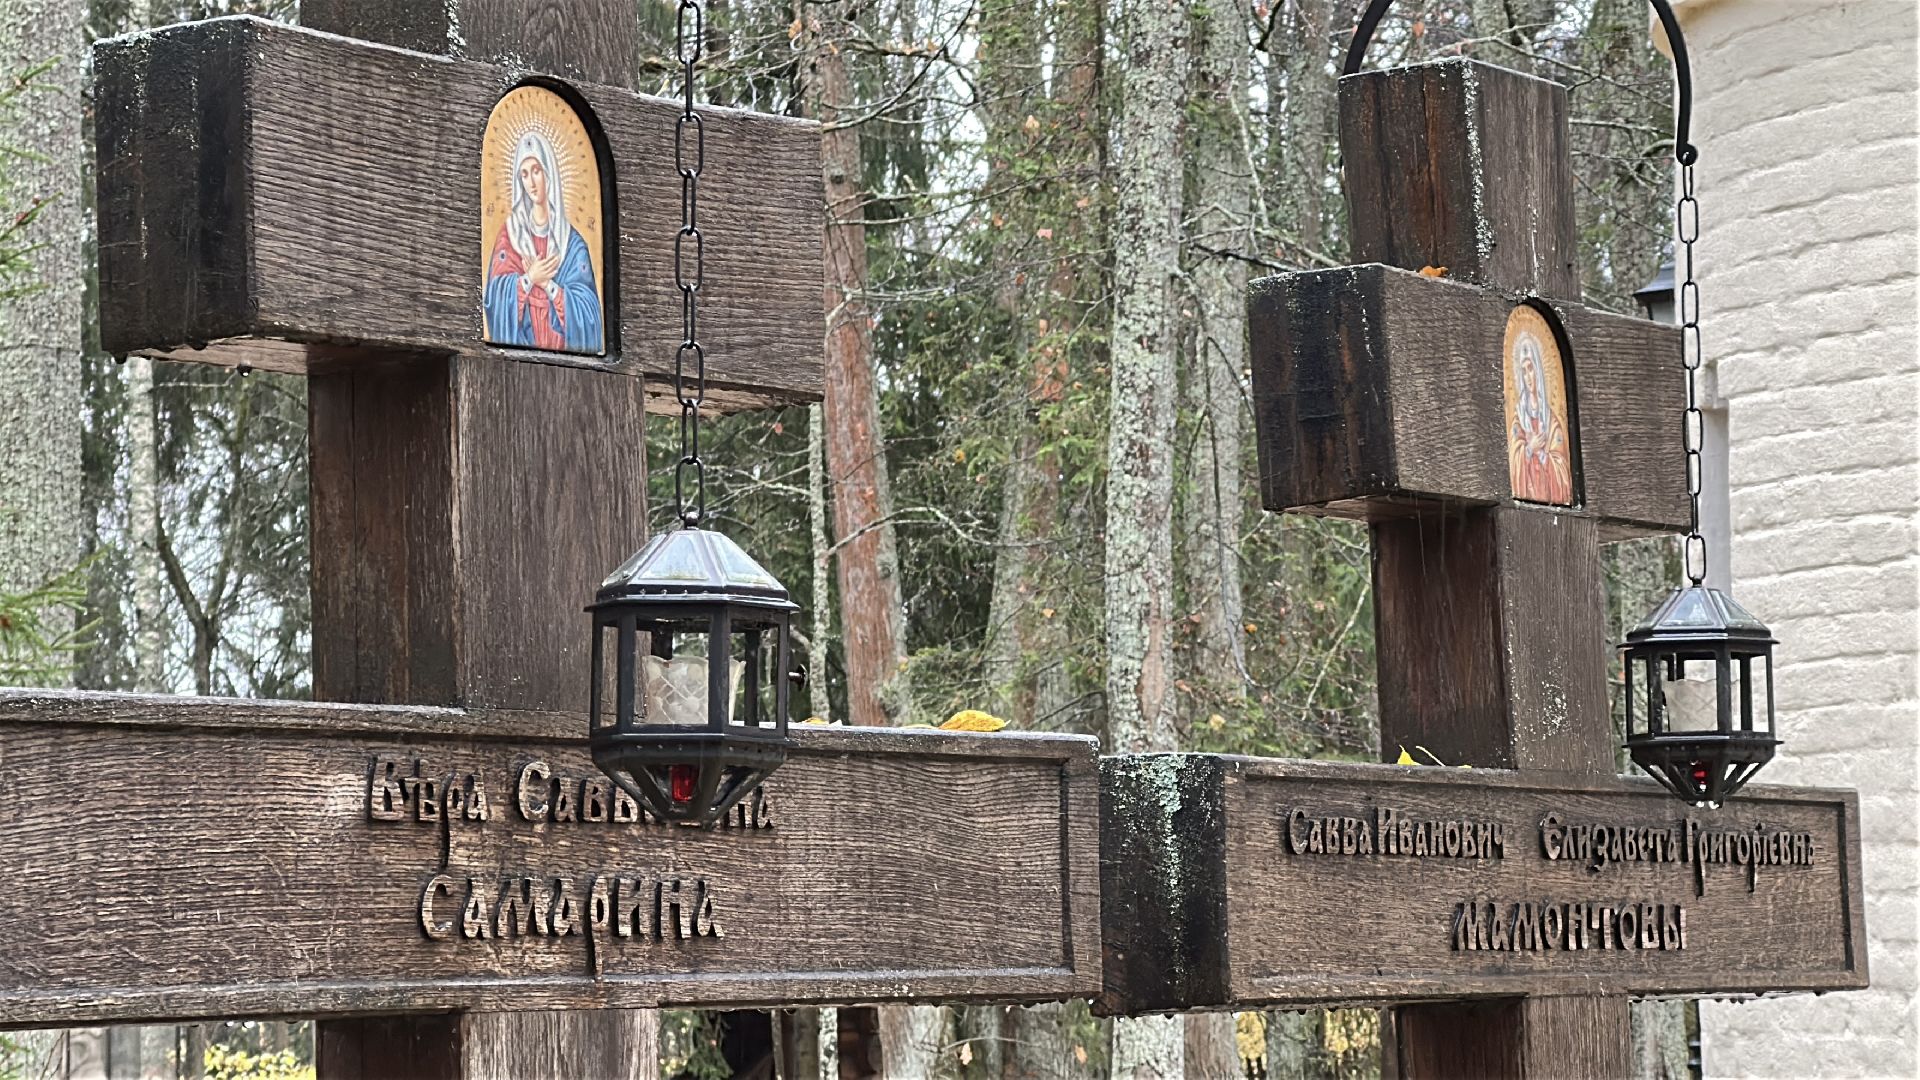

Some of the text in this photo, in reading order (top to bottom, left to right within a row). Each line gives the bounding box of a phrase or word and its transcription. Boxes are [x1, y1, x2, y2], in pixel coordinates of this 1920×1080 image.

[517, 760, 776, 829] Саввна
[1287, 805, 1373, 856] Савва
[1373, 806, 1505, 860] Иванович
